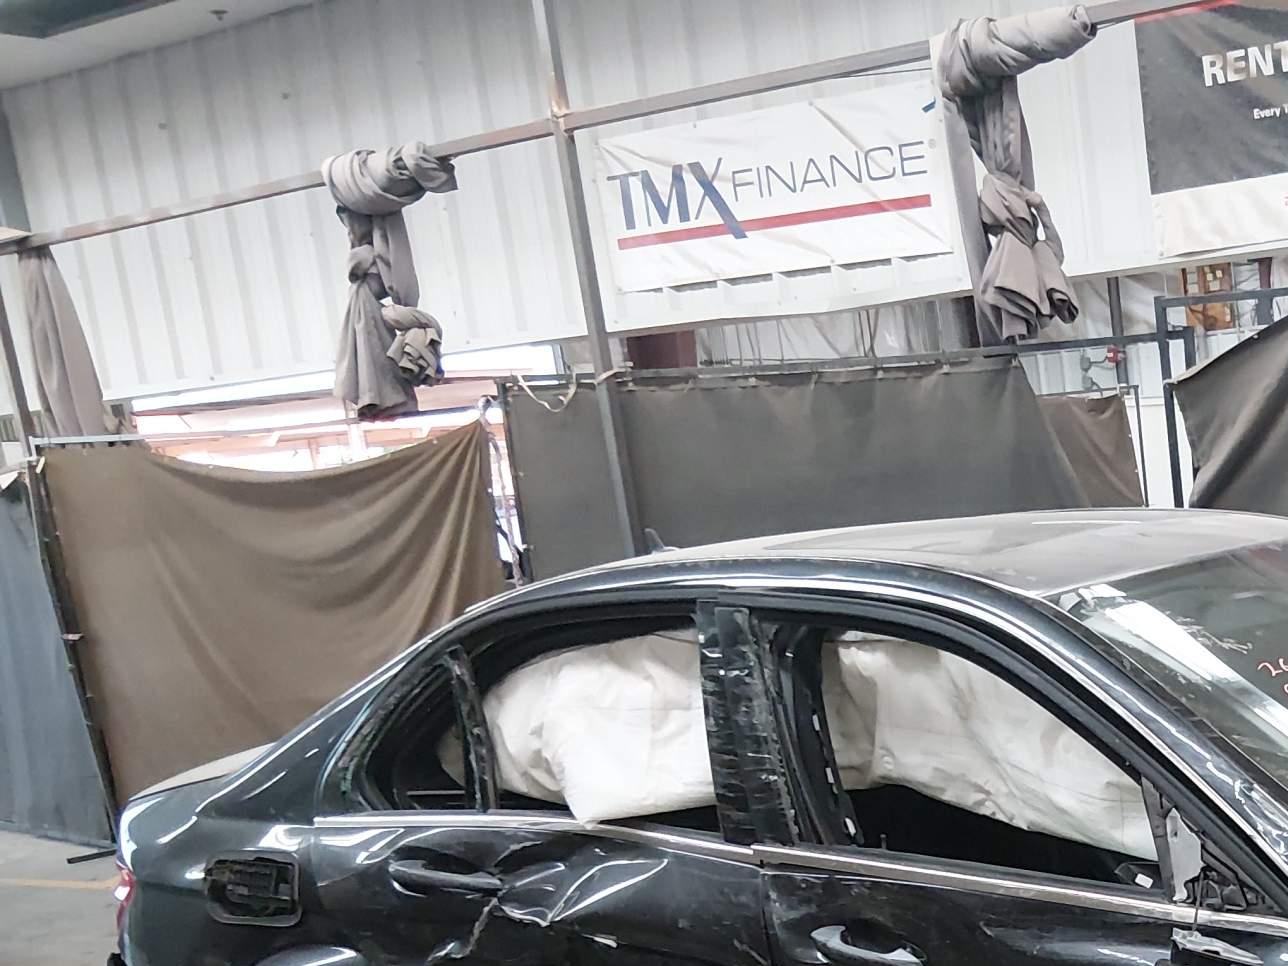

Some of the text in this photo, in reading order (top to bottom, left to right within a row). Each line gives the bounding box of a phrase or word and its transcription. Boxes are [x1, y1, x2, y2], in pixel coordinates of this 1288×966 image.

[1253, 106, 1281, 120] Every
[606, 140, 929, 240] TMX FINANCE
